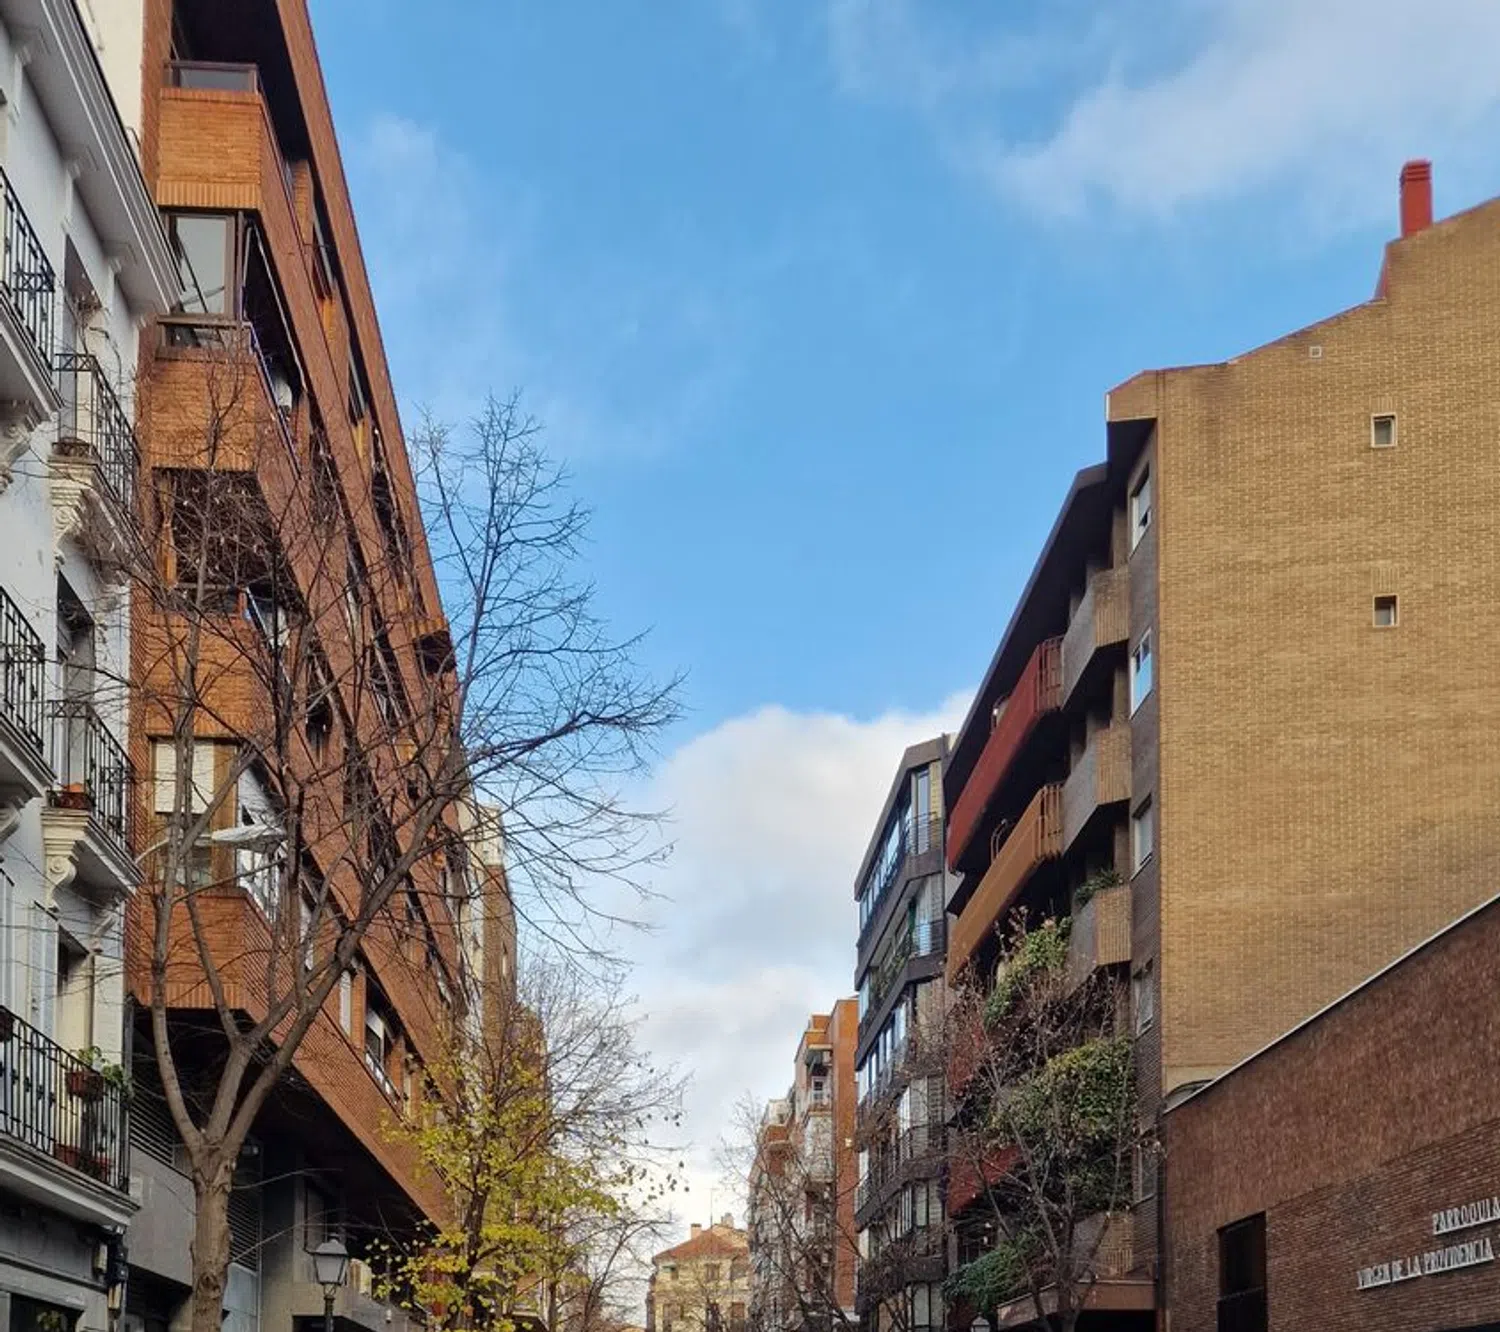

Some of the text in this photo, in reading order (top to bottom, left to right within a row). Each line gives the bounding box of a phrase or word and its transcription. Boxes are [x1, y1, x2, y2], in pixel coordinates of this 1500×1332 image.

[1432, 1196, 1500, 1235] PARROQUIA
[1391, 1259, 1404, 1282] DE
[1406, 1254, 1421, 1278] LA
[1422, 1237, 1495, 1275] PROVIDENCIA
